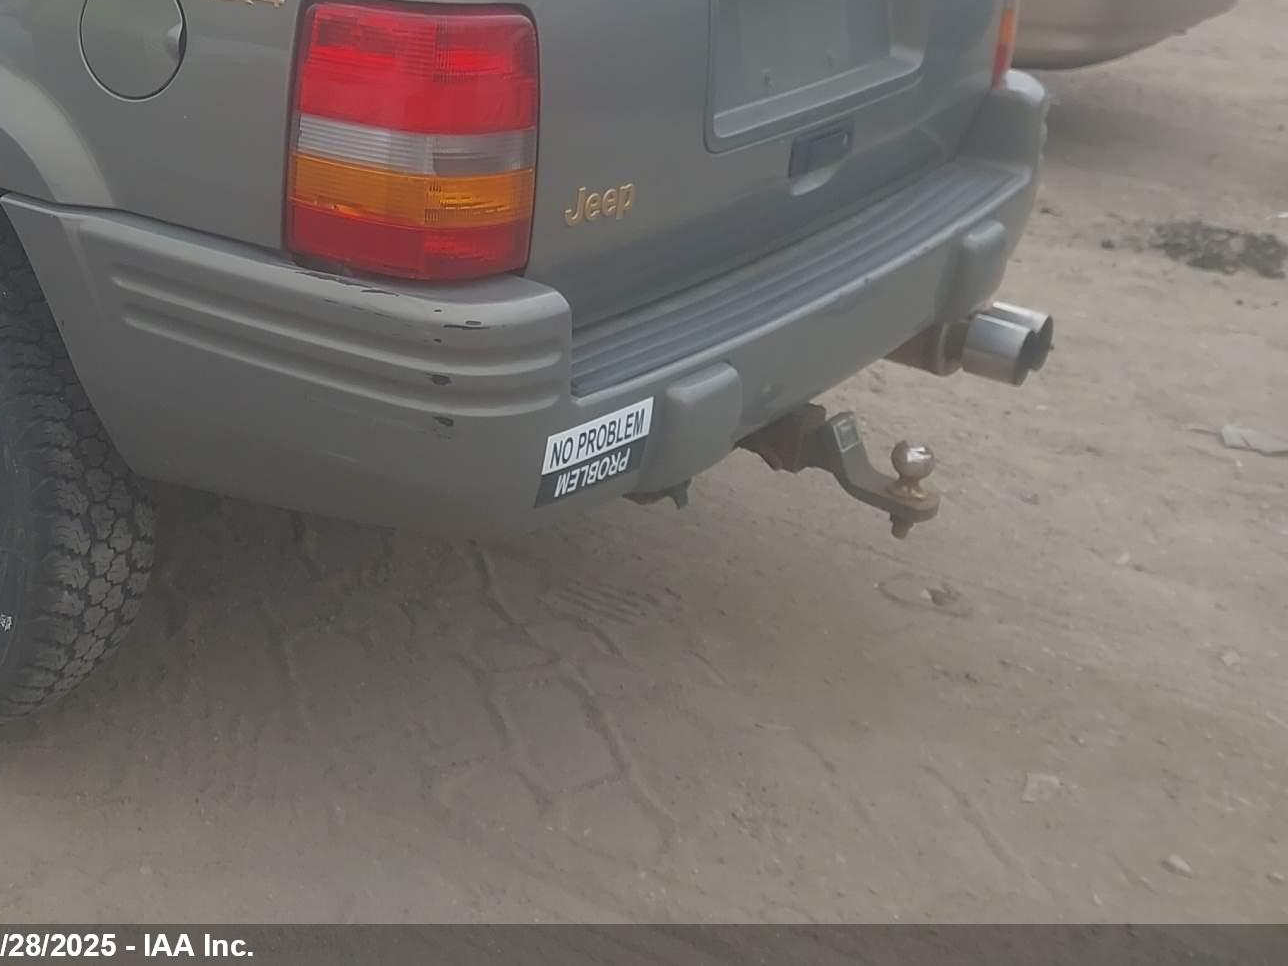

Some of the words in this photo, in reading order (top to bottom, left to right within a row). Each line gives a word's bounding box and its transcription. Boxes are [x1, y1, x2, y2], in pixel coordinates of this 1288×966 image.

[564, 183, 634, 226] Jeep
[550, 436, 573, 468] NO
[576, 408, 645, 459] PROBLEM
[554, 447, 631, 498] PROBLEM
